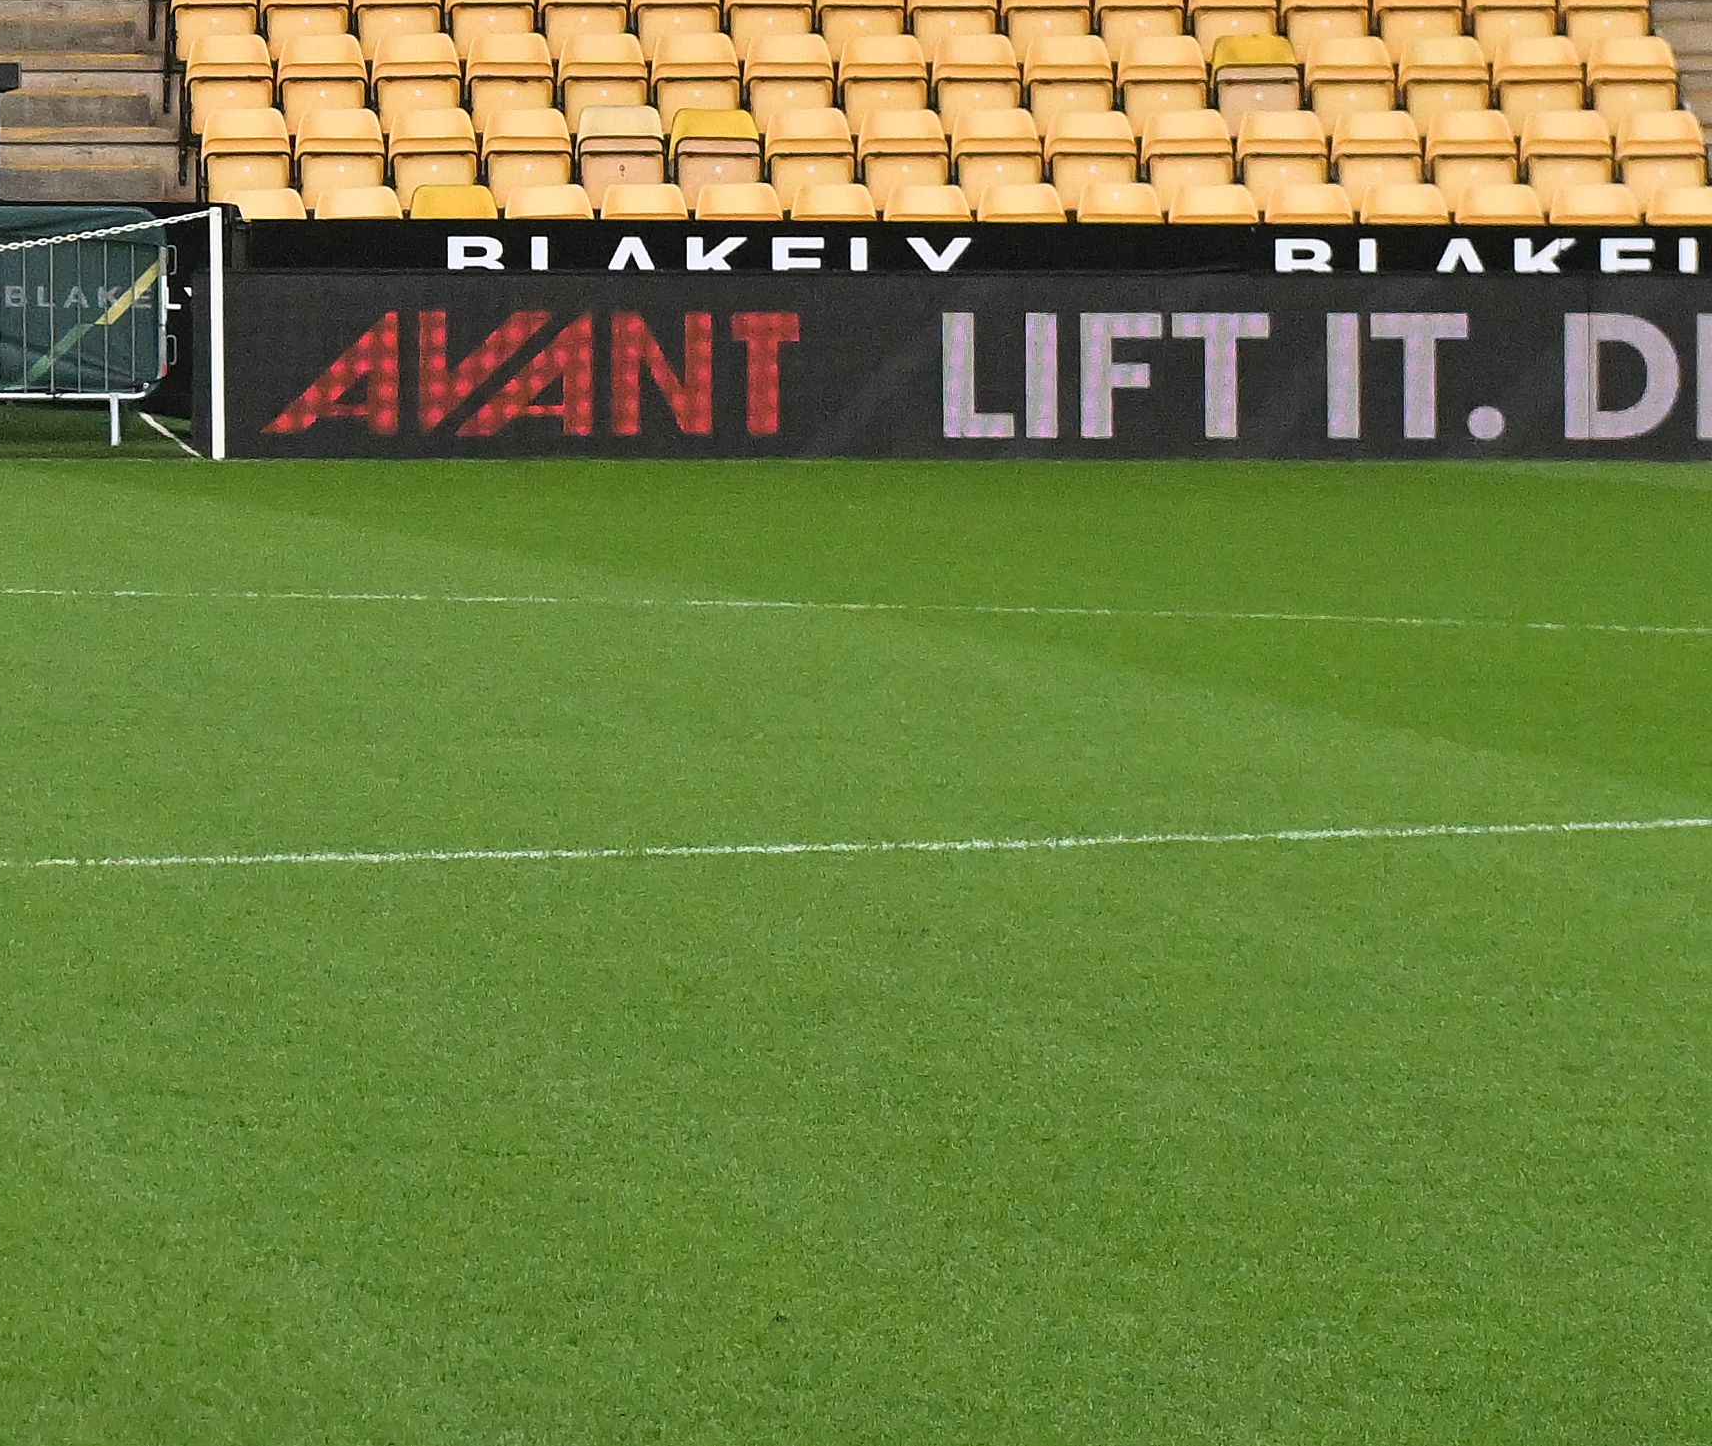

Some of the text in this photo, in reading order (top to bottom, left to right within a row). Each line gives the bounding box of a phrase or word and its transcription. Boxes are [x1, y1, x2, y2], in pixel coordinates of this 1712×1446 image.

[260, 309, 801, 437] AVANT
[942, 312, 1712, 440] LIFT IT. D
